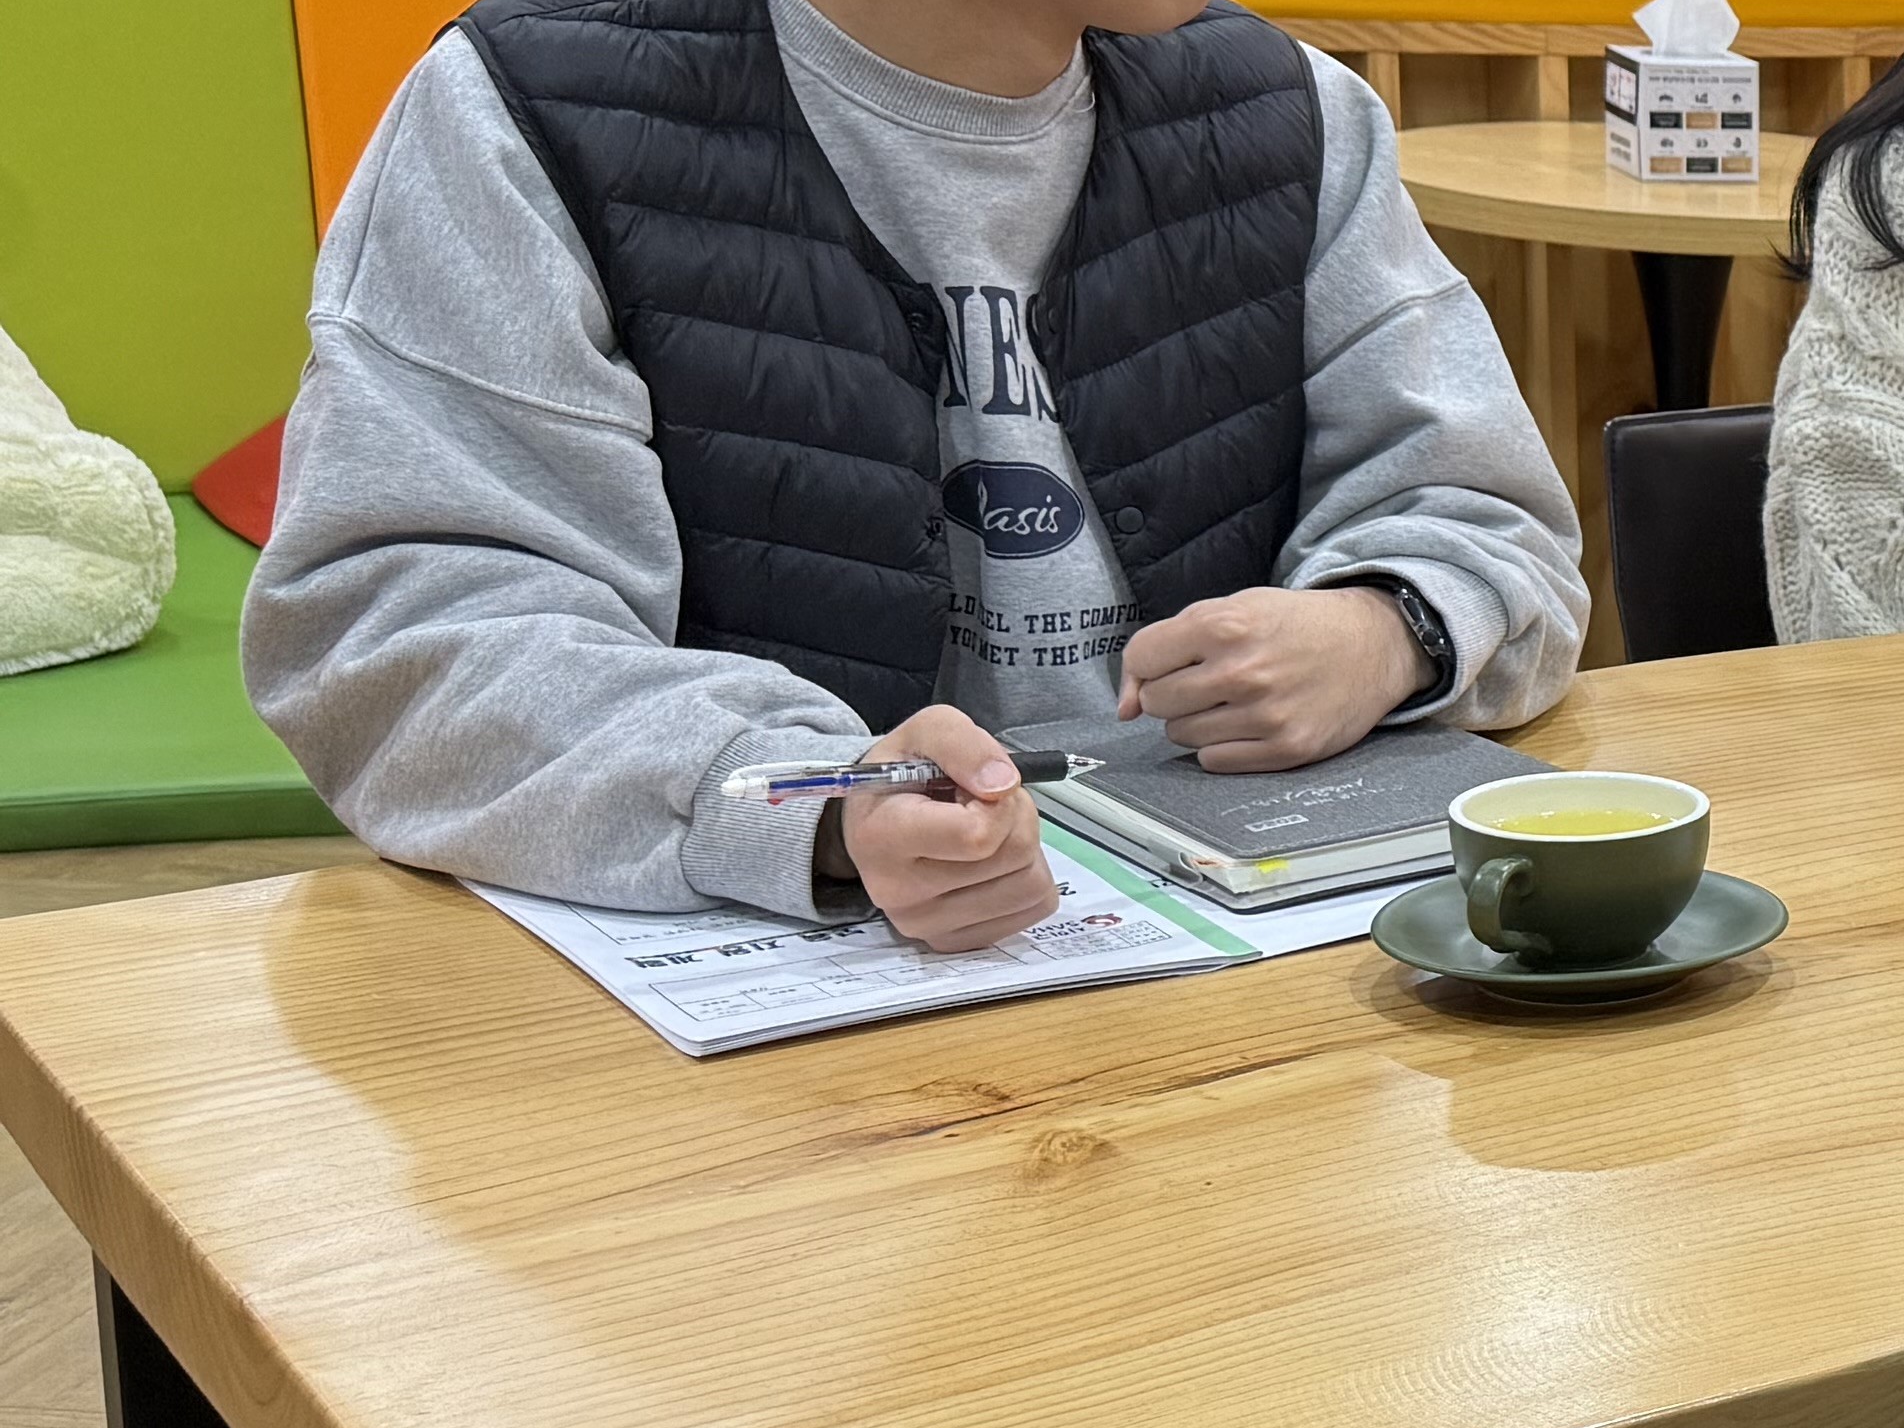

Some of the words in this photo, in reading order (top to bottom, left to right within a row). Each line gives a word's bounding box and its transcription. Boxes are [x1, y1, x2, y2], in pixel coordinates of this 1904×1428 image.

[978, 477, 1061, 535] asis
[1024, 612, 1072, 634] THE
[1033, 643, 1079, 666] THE
